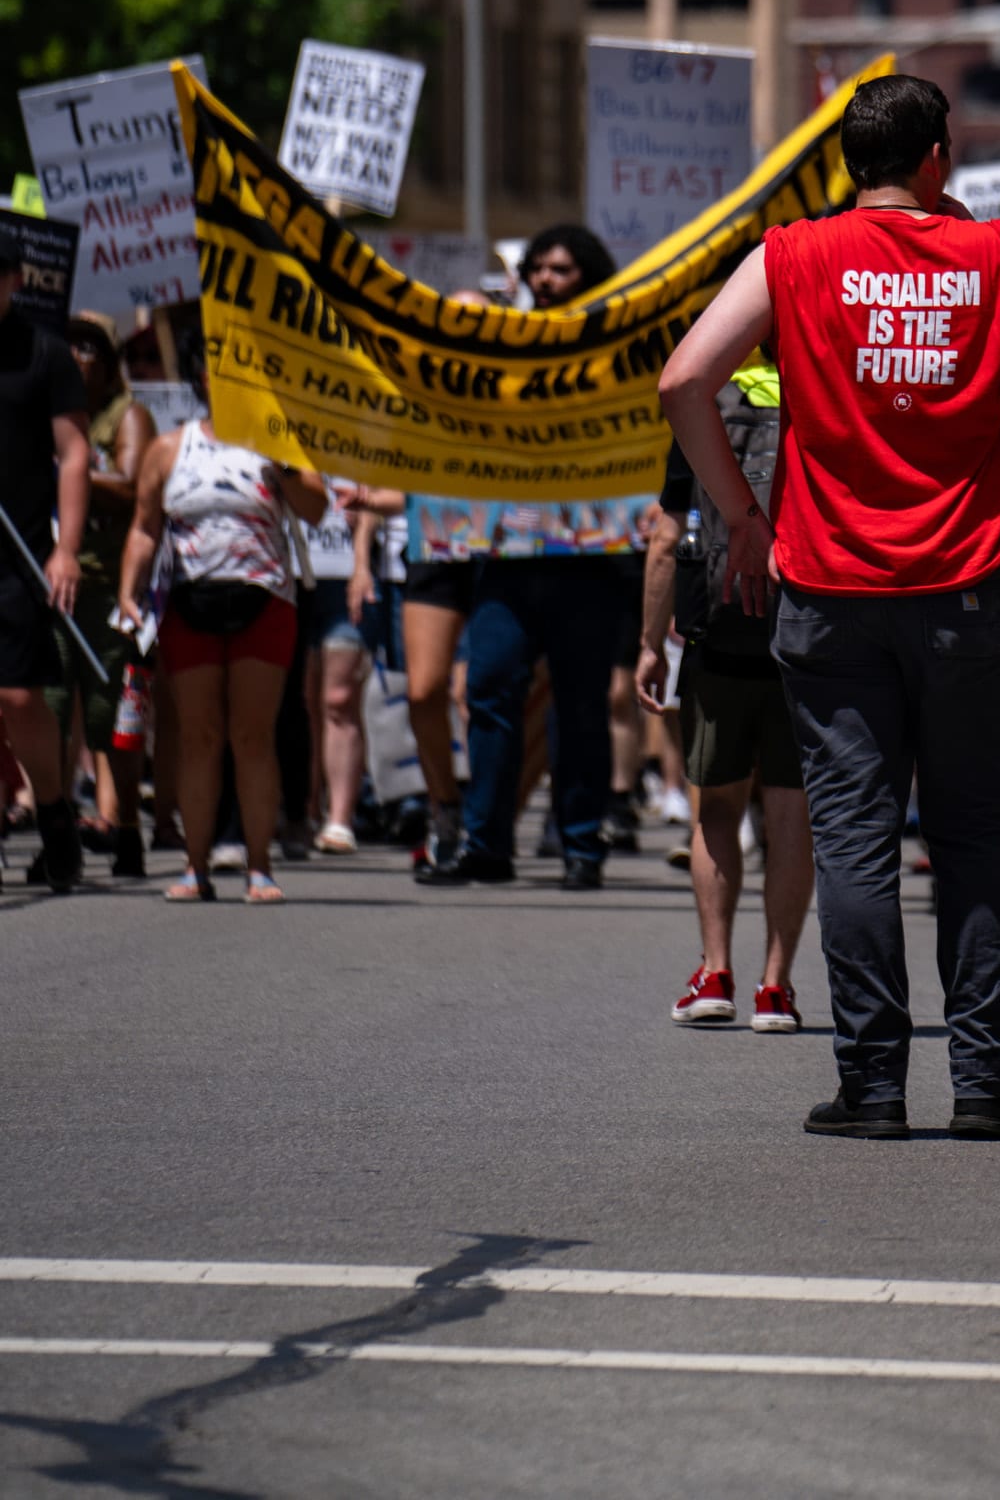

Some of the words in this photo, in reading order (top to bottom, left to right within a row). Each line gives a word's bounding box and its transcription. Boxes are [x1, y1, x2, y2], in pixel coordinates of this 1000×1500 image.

[611, 158, 731, 200] FEAST
[92, 234, 197, 276] Alcatra
[841, 269, 981, 308] SOCIALISM
[867, 309, 895, 345] IS
[900, 310, 952, 346] THE
[418, 351, 505, 402] FOR
[518, 360, 599, 402] ALL
[856, 348, 958, 386] FUTURE
[232, 340, 292, 385] U.S.
[303, 367, 431, 425] HANDS
[436, 410, 497, 440] OFF
